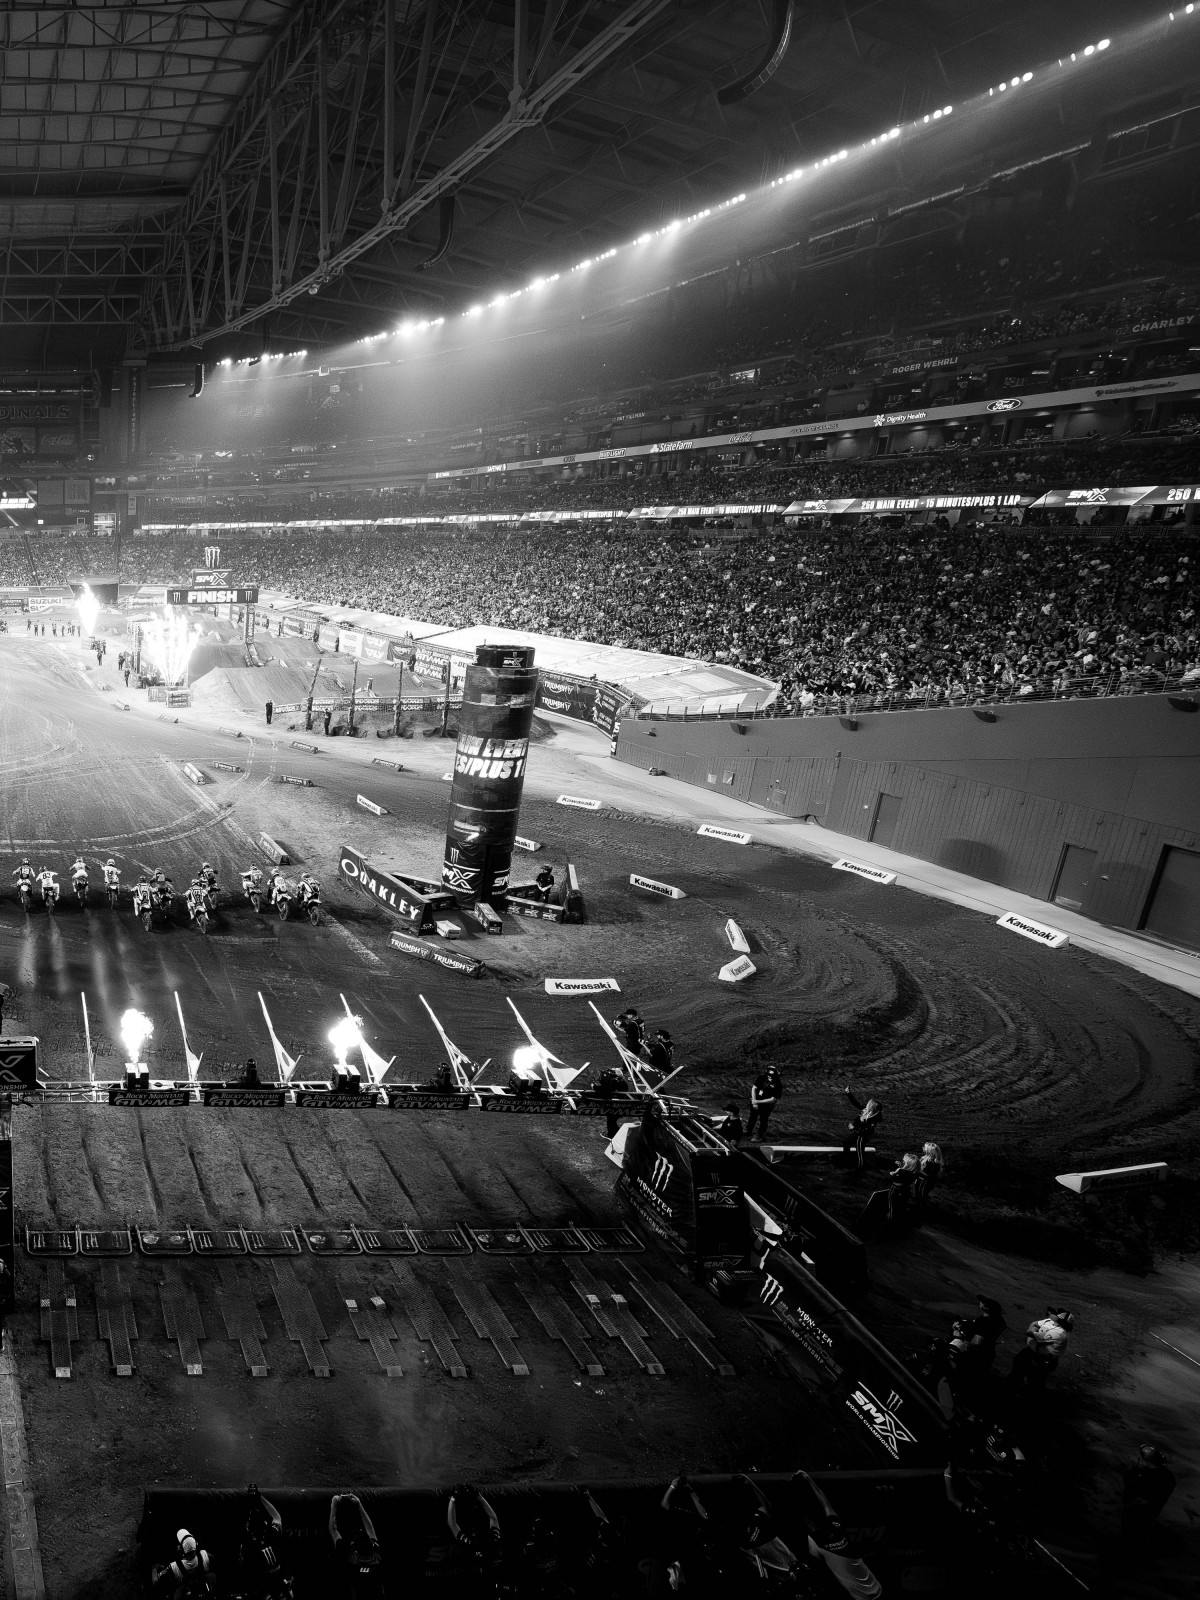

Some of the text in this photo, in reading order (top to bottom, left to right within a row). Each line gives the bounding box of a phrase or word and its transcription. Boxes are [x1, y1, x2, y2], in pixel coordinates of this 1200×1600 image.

[1132, 315, 1194, 333] CHARLEY
[892, 356, 959, 374] ROGER WEHRLI
[886, 412, 926, 424] Dignity Health
[1067, 488, 1110, 502] SMX
[1167, 488, 1191, 500] 250
[879, 500, 896, 509] MAIN
[897, 499, 918, 508] EVENT
[936, 496, 994, 507] MINUTES/PLUS
[1003, 495, 1020, 505] LAP
[195, 572, 228, 585] SMX
[187, 590, 238, 603] FINISH
[544, 681, 568, 692] TRIUMPH
[541, 697, 565, 709] TRIUMPH
[561, 797, 595, 806] Kawasaki
[704, 827, 745, 839] Kawasaki
[841, 861, 888, 879] Kawasaki
[634, 878, 673, 897] Kawasaki
[1006, 916, 1058, 942] Kawasaki
[391, 938, 421, 953] TRIUMPH
[433, 953, 466, 969] TRIUMPH
[555, 981, 612, 990] Kawasaki
[636, 1176, 673, 1218] MONSTER
[699, 1189, 737, 1205] SMX
[851, 1390, 911, 1453] SMX
[845, 1400, 900, 1460] WORLD CHAMPIONSHIP
